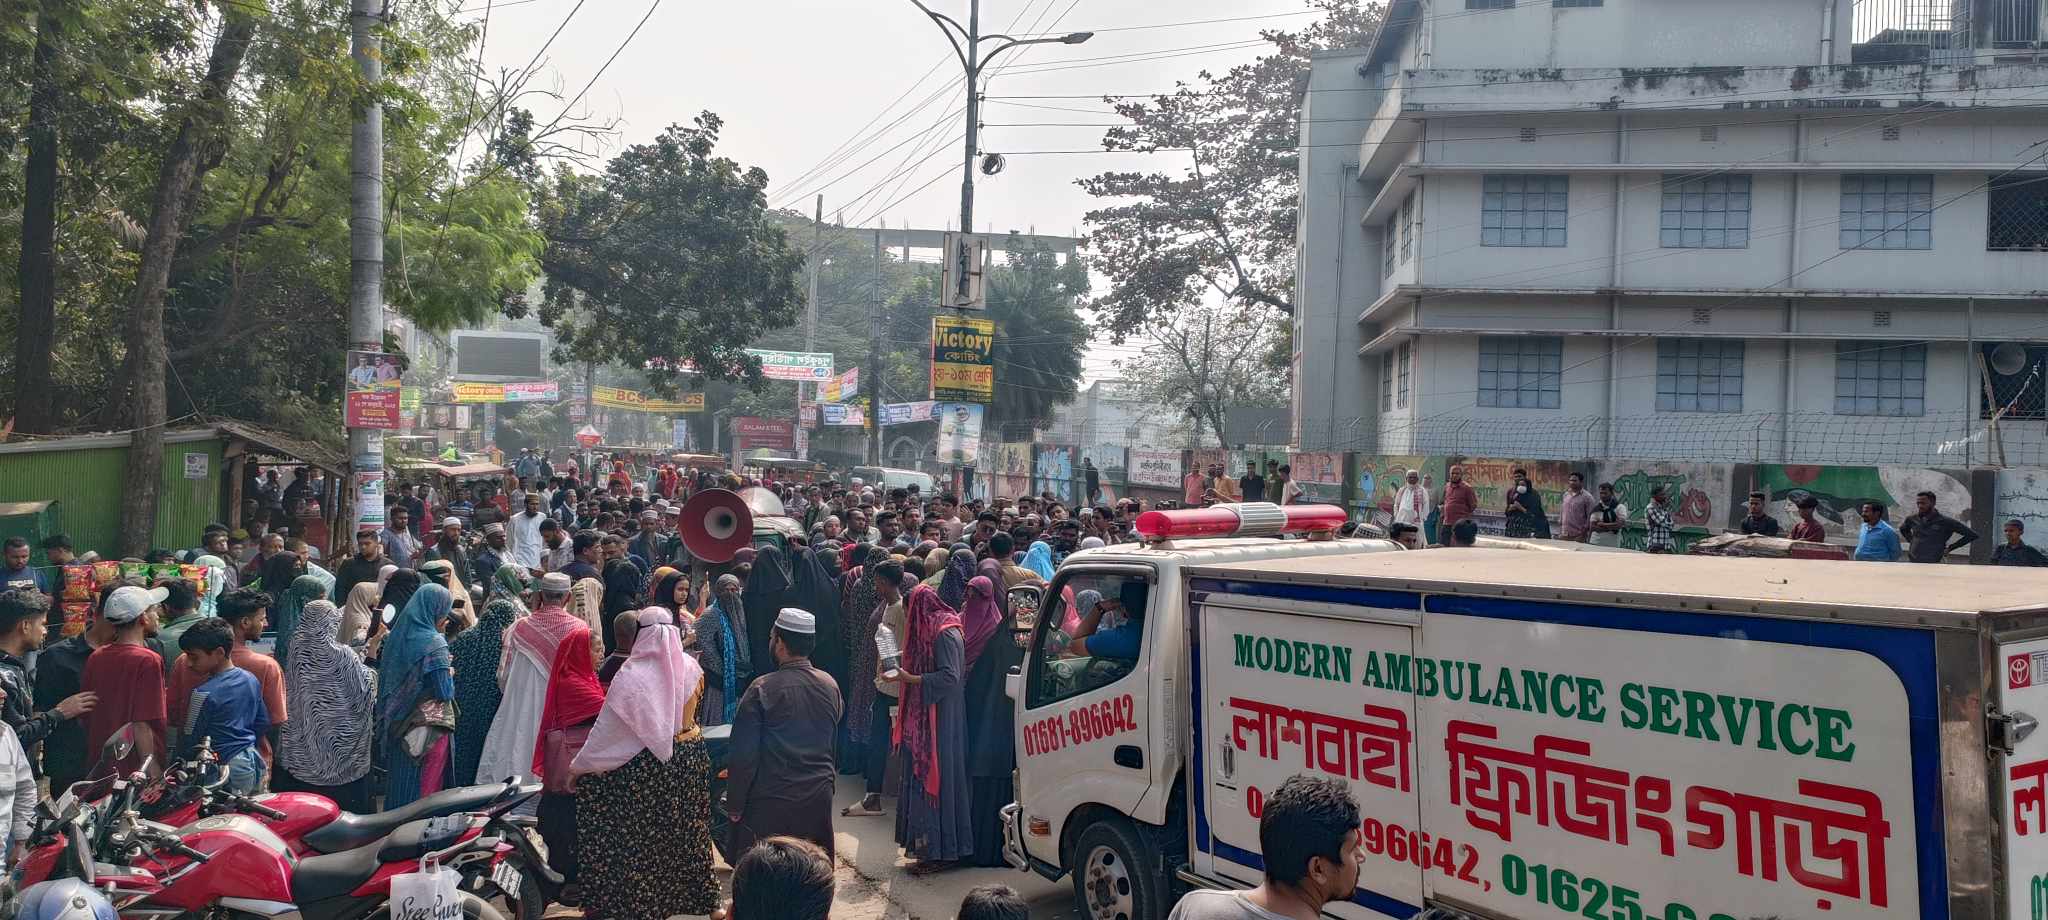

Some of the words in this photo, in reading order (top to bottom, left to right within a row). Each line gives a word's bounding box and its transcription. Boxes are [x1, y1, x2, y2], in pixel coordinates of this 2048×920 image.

[936, 327, 992, 356] Victory
[944, 350, 982, 364] কোচিং
[1023, 694, 1137, 757] 01681-896642
[1233, 634, 1352, 683] MODERN
[1362, 650, 1606, 723] AMBULANCE
[1619, 682, 1856, 762] SERVICE
[1230, 696, 1412, 792] লাশবাহী
[1445, 719, 1675, 857] ফ্রিজিং
[1685, 778, 1891, 910] গাড়ী
